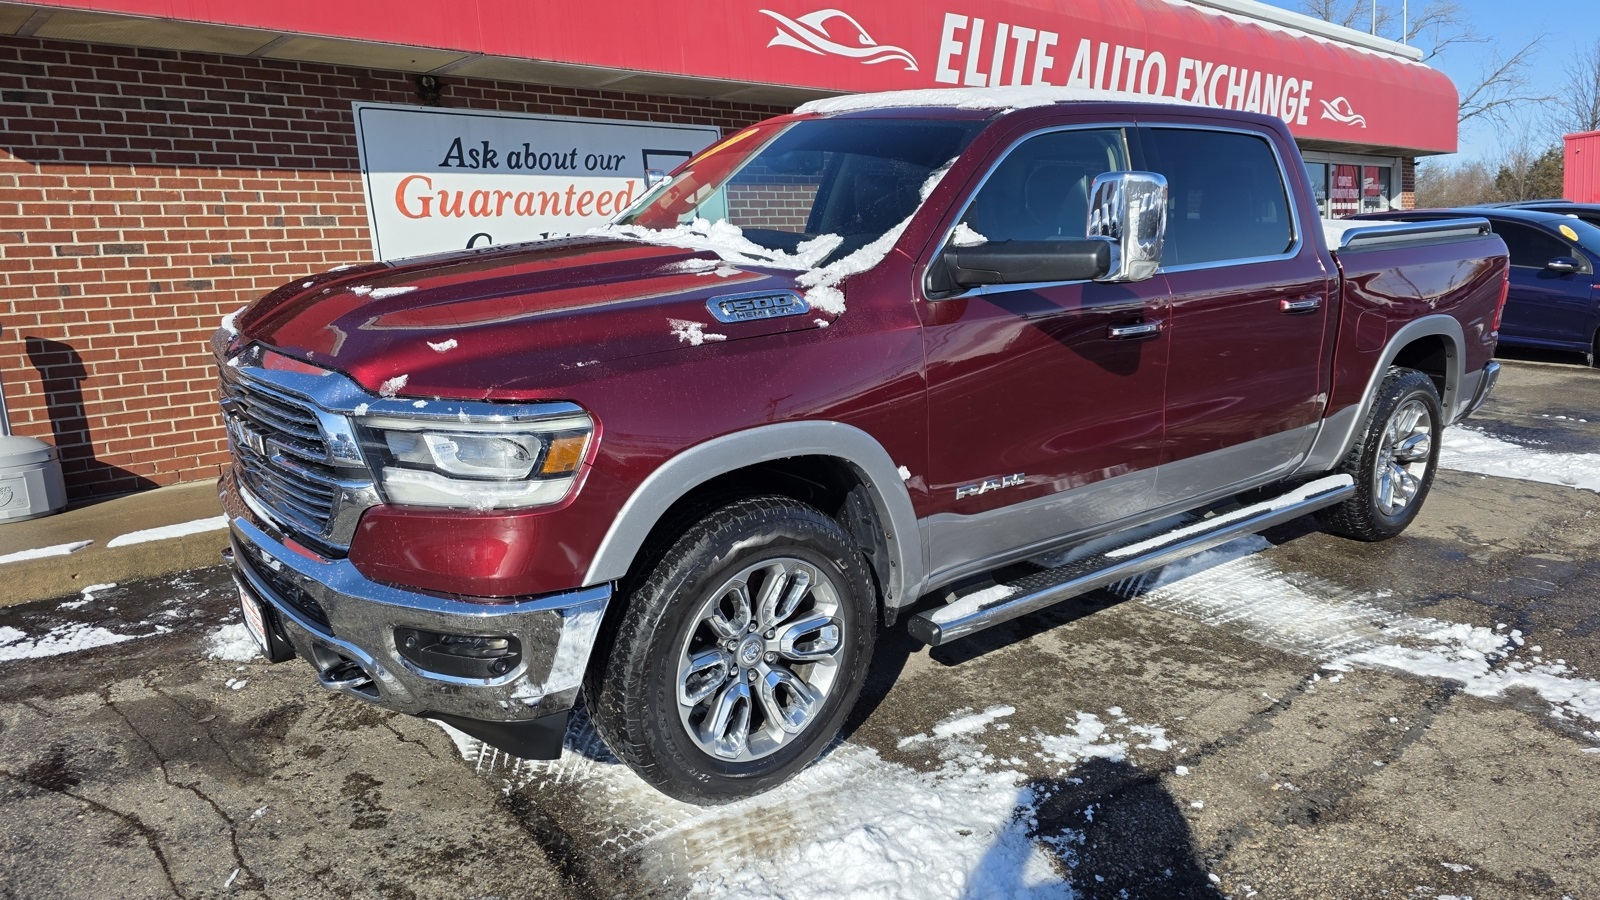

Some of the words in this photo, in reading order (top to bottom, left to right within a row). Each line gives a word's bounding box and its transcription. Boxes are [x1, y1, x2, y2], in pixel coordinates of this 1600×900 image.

[935, 12, 1059, 88] ELITE
[1066, 38, 1167, 97] AUTO
[1175, 57, 1313, 126] EXCHANGE
[438, 136, 500, 170] Ask
[506, 142, 578, 171] about
[584, 153, 626, 172] our
[395, 174, 636, 220] Guaranteed
[725, 296, 793, 313] 1500
[955, 472, 1026, 500] RAM
